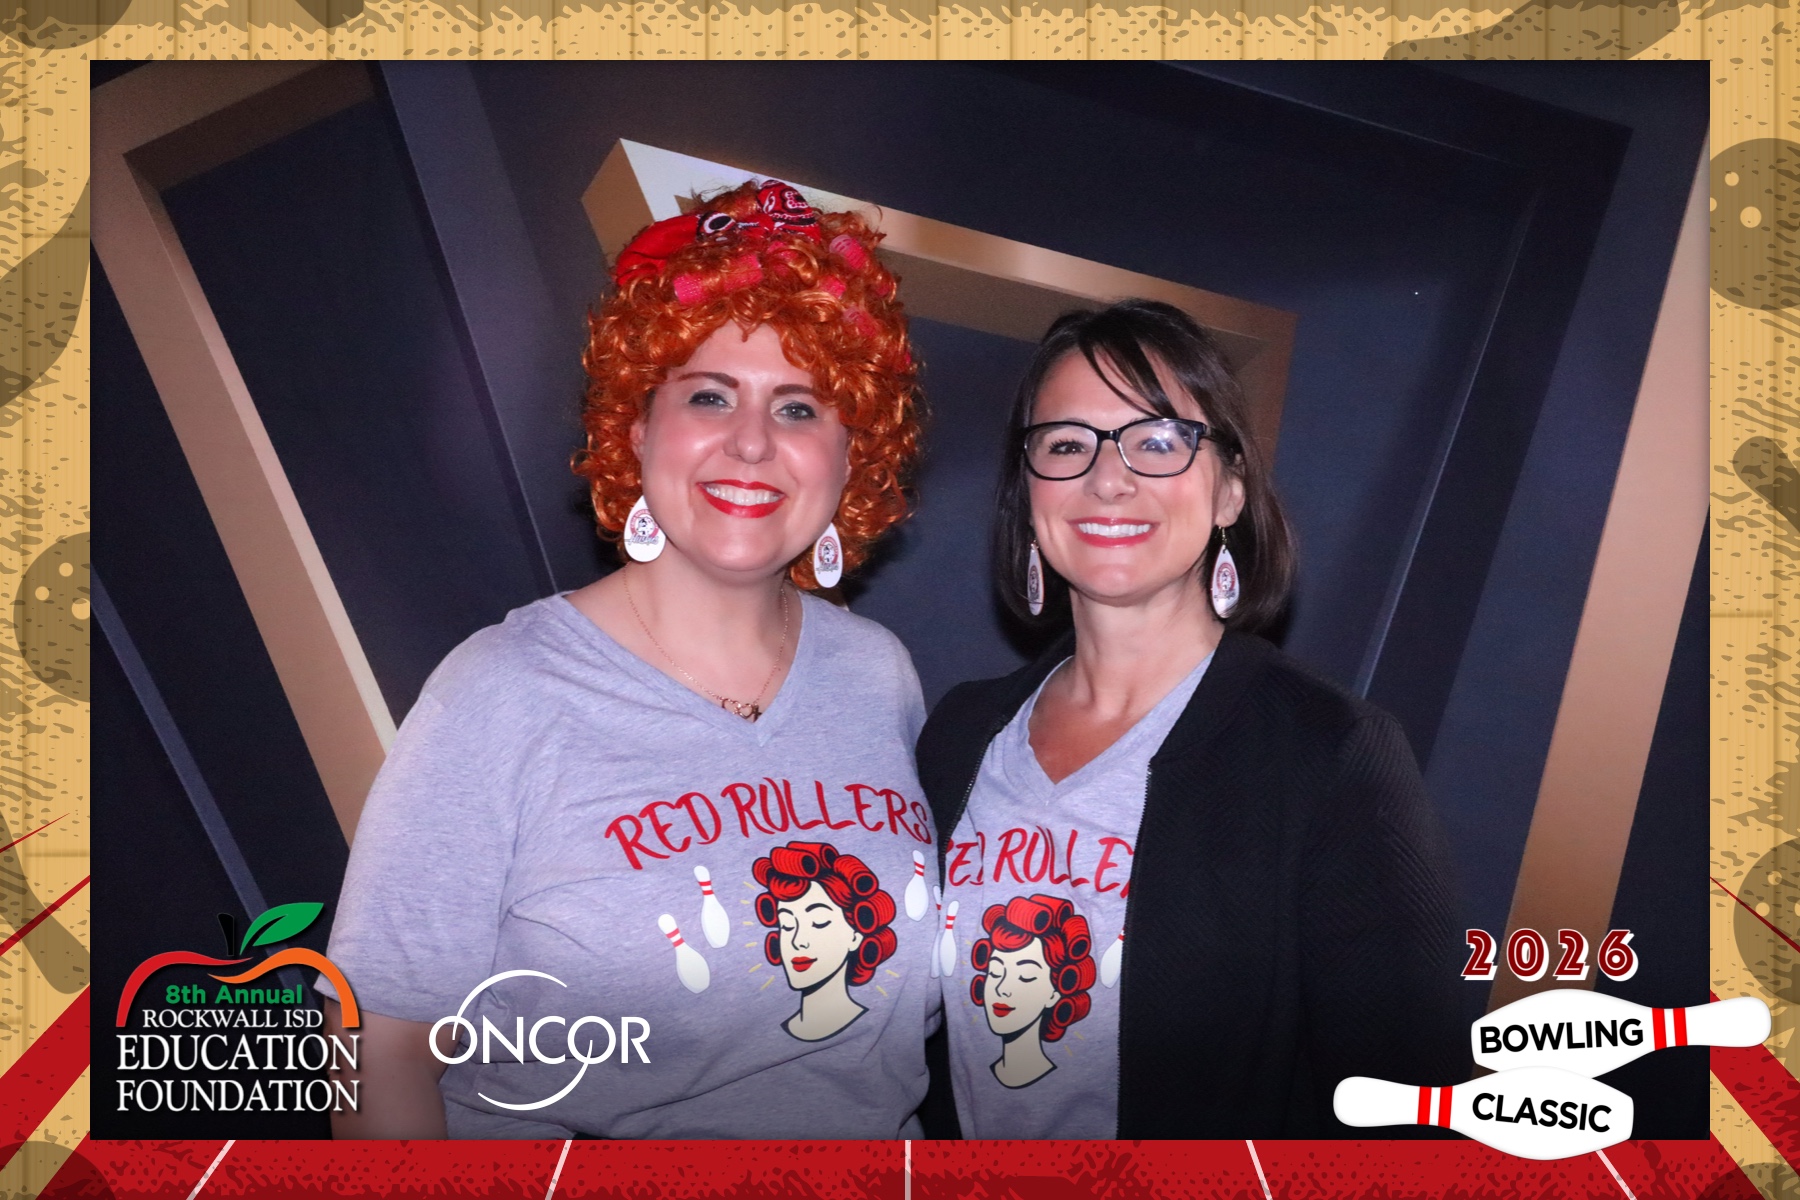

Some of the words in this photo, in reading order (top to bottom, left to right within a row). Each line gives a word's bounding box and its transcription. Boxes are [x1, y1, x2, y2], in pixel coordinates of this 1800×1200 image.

[604, 791, 722, 871] RED
[720, 777, 933, 845] ROLLERS
[993, 825, 1135, 899] ROLLE
